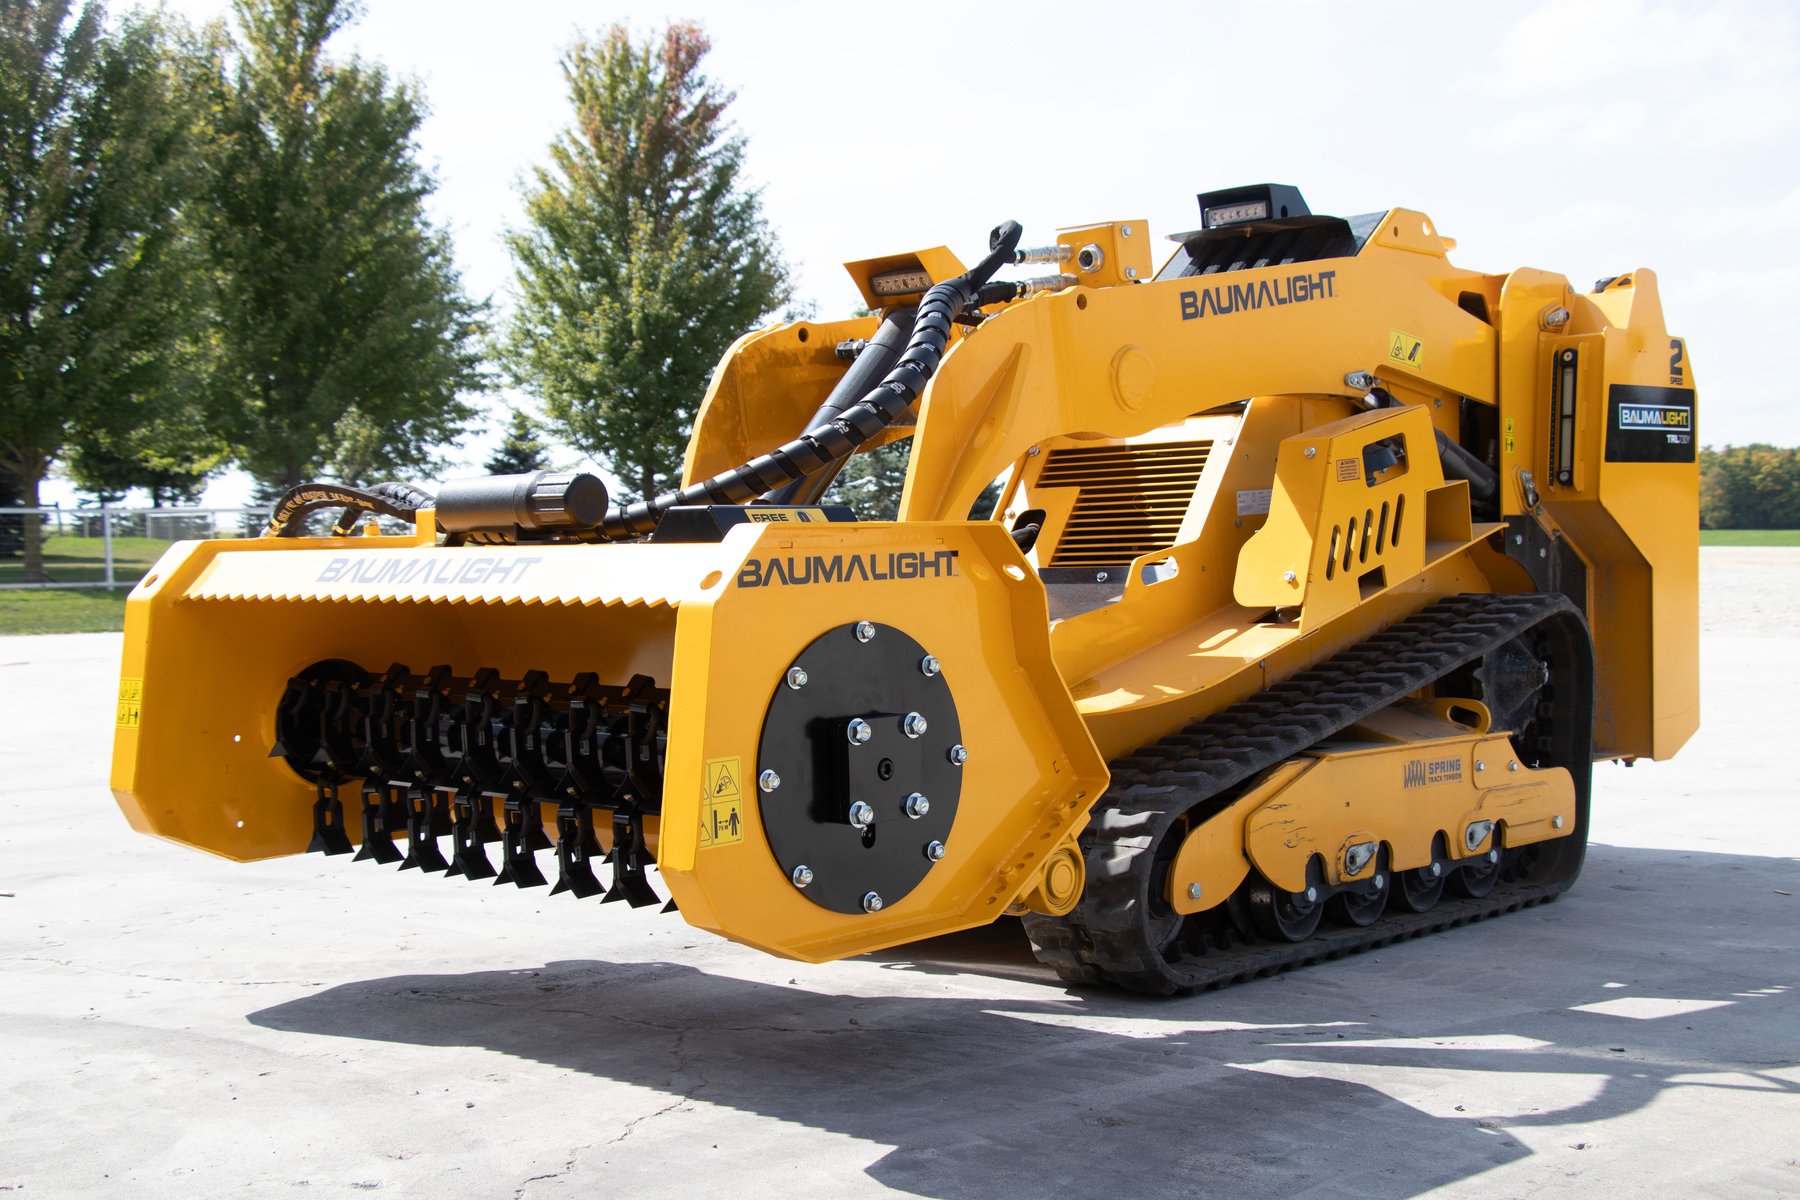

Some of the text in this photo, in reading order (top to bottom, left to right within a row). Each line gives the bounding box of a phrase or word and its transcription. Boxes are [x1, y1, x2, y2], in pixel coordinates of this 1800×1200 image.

[1180, 271, 1336, 320] BAUMALIGHT
[1670, 339, 1683, 376] 2
[1622, 409, 1688, 425] BAUMALIGHT
[316, 557, 544, 584] BAUMALIGHT
[738, 550, 958, 588] BAUMALIGHT
[1428, 759, 1461, 775] SPRING
